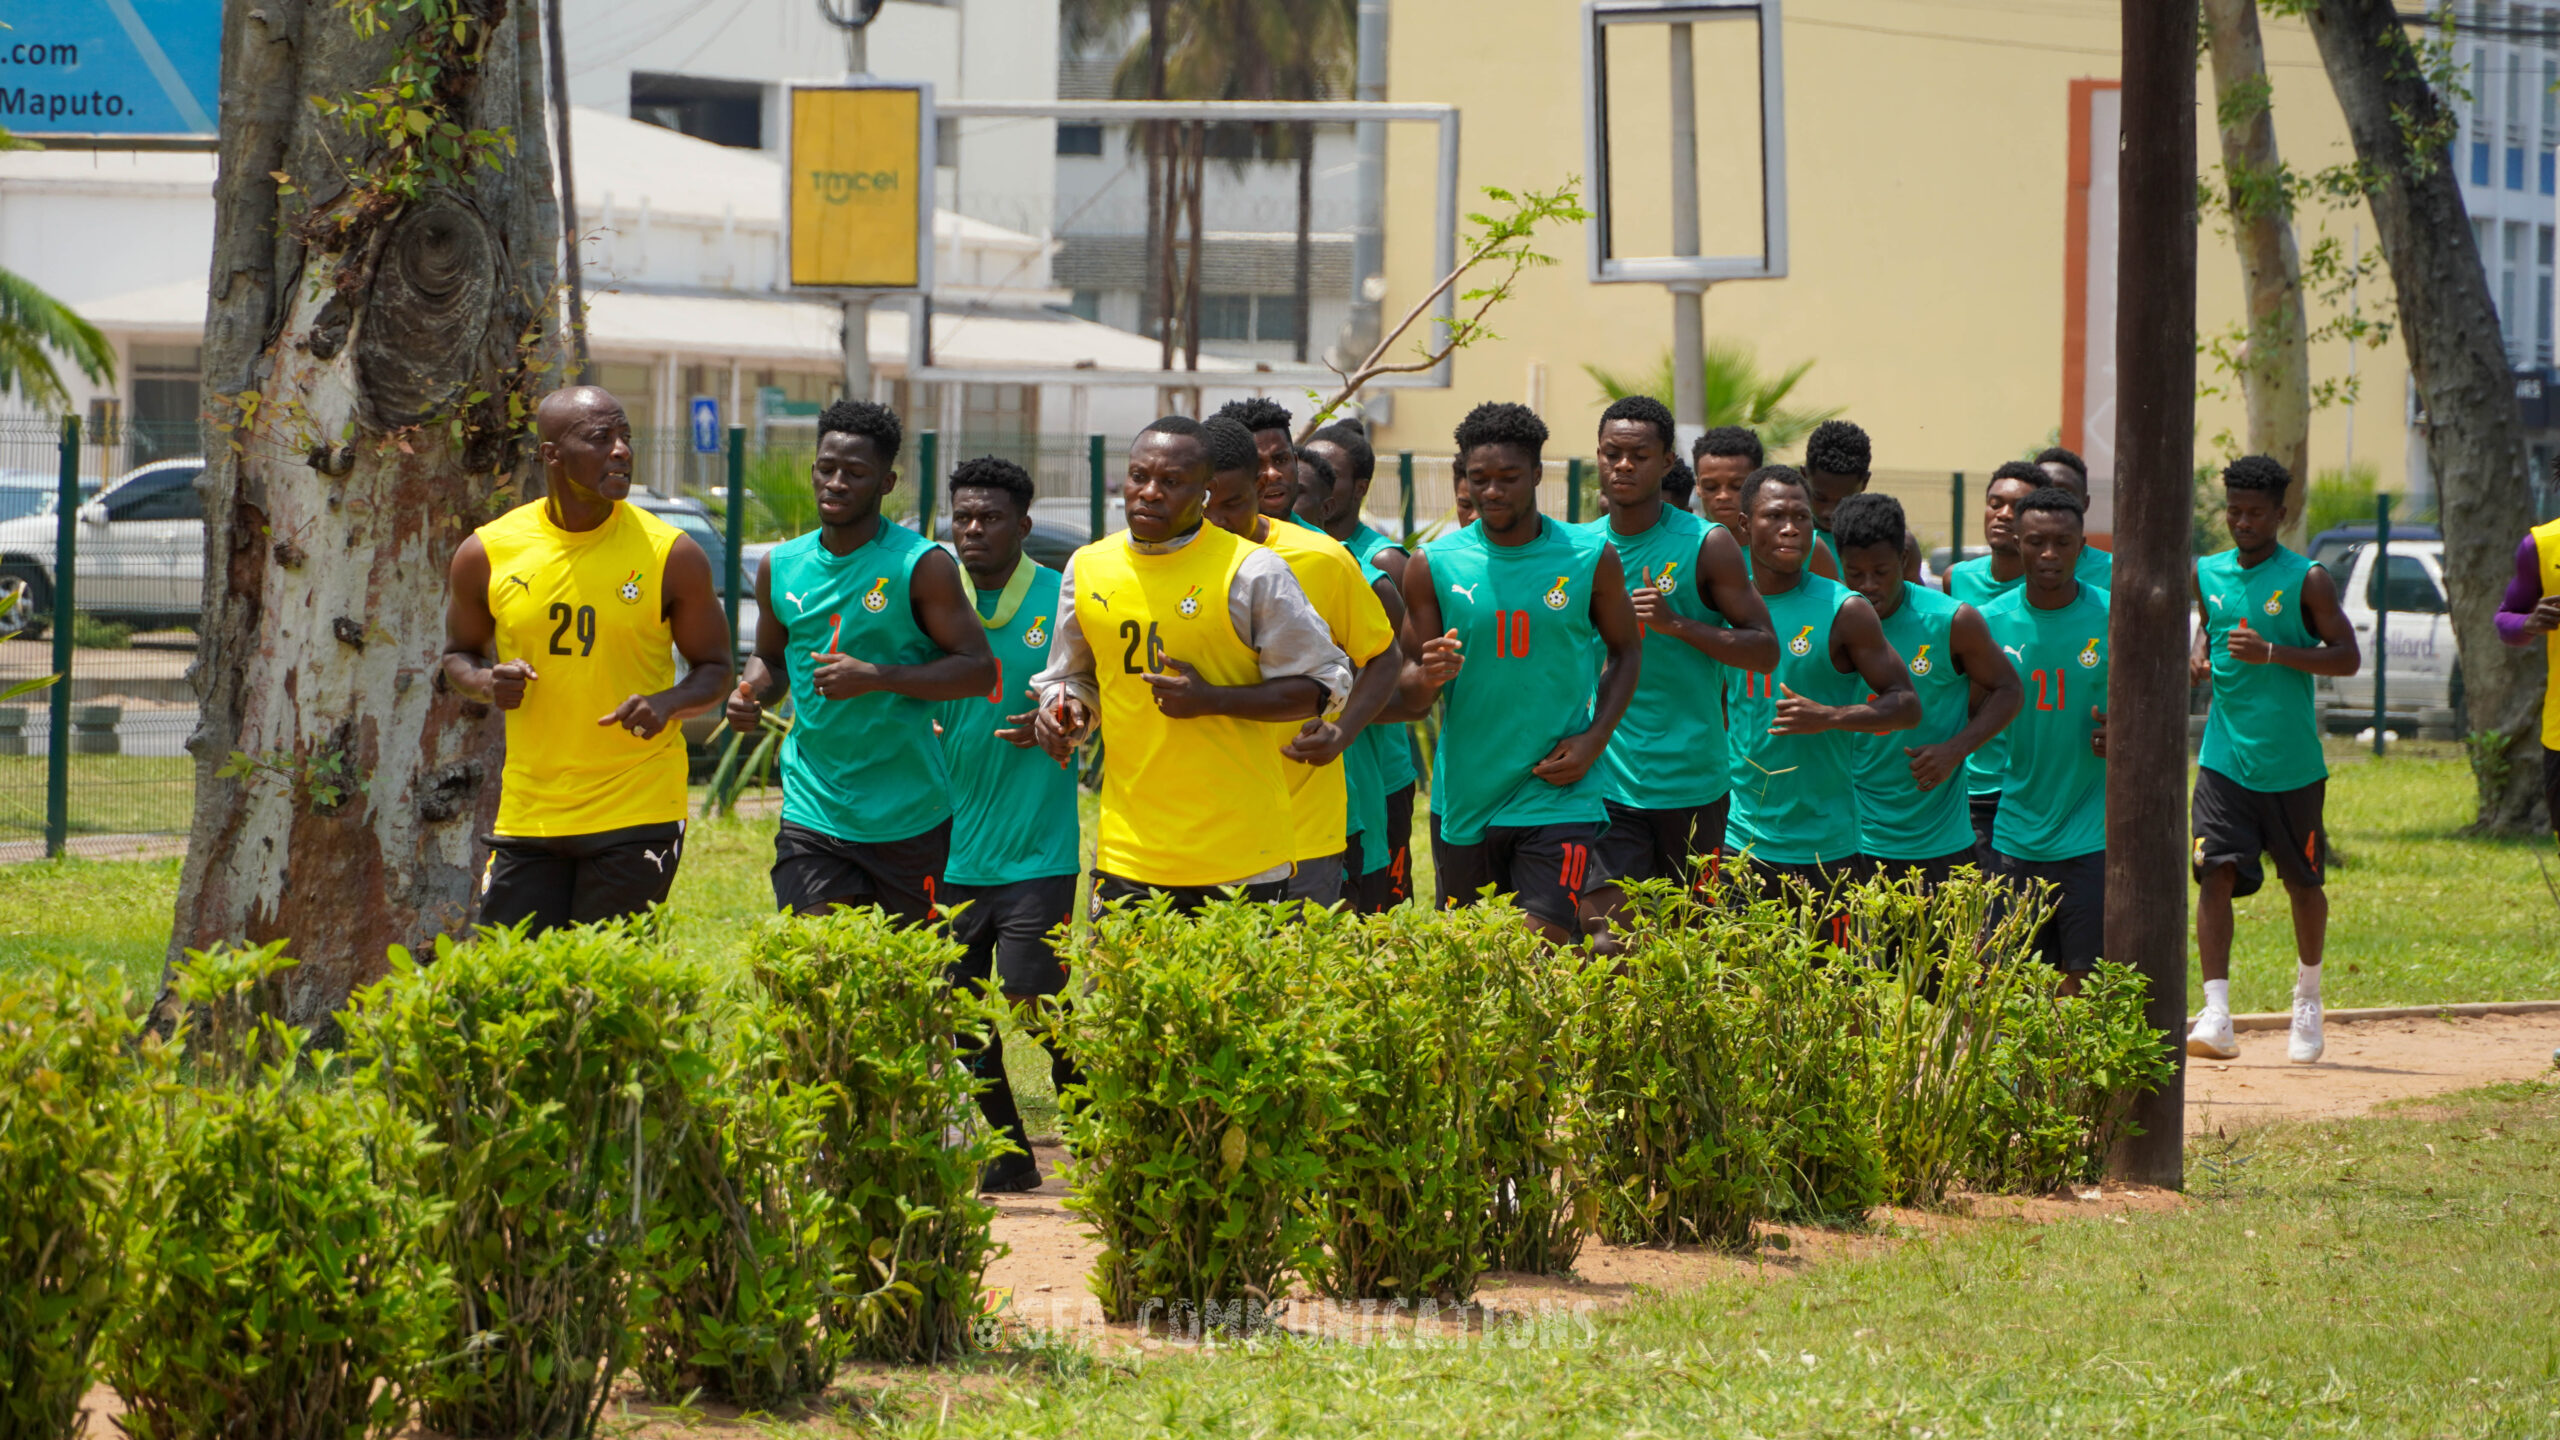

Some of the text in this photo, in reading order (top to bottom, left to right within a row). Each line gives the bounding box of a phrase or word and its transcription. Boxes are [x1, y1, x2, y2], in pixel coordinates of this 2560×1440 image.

[0, 87, 134, 122] Maputo.
[549, 602, 596, 657] 29
[1120, 619, 1165, 675] 26
[1495, 609, 1531, 659] 10
[2031, 668, 2065, 711] 21
[1558, 842, 1588, 892] 10
